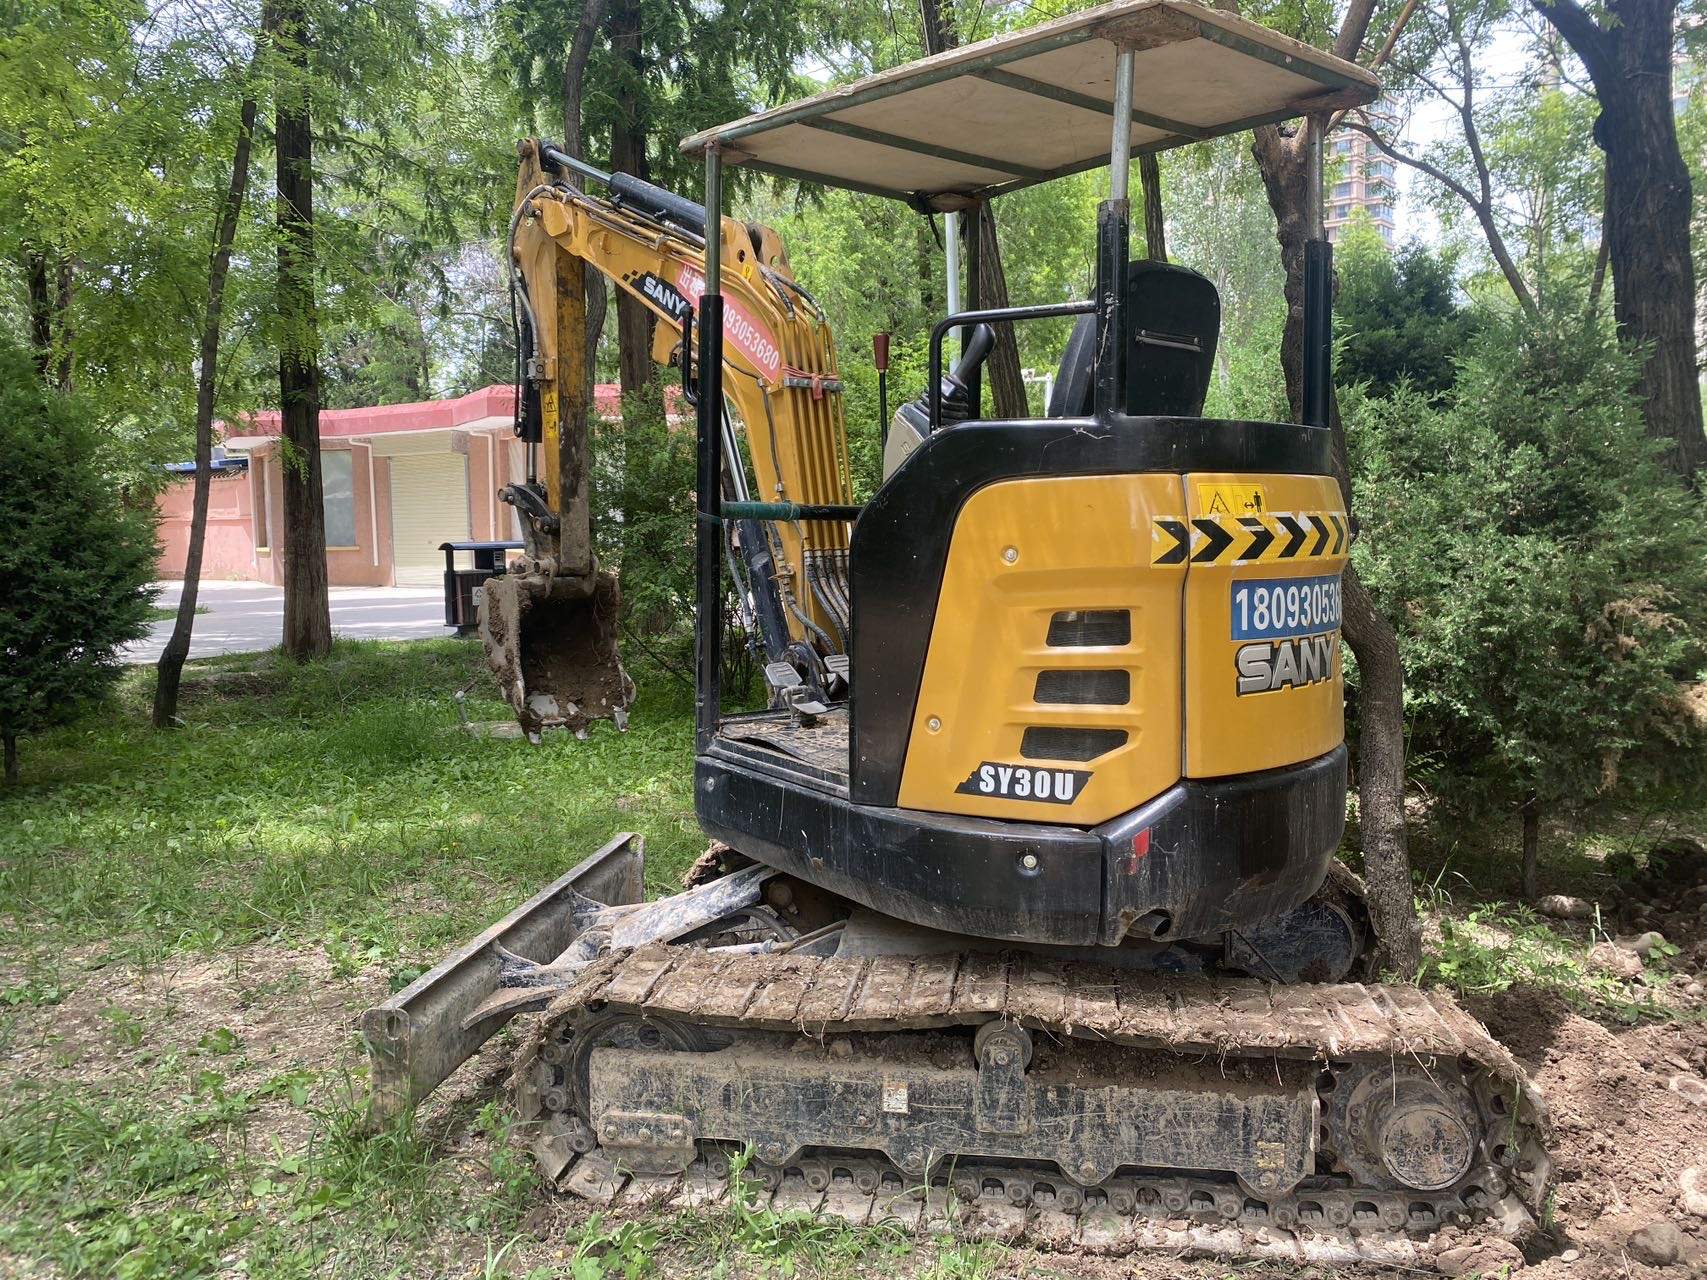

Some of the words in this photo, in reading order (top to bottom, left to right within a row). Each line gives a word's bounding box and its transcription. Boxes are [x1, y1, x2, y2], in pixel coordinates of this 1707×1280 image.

[643, 276, 686, 314] SANY
[1235, 583, 1342, 631] 180930536
[1237, 635, 1336, 694] SANY
[979, 765, 1074, 801] SY30U
